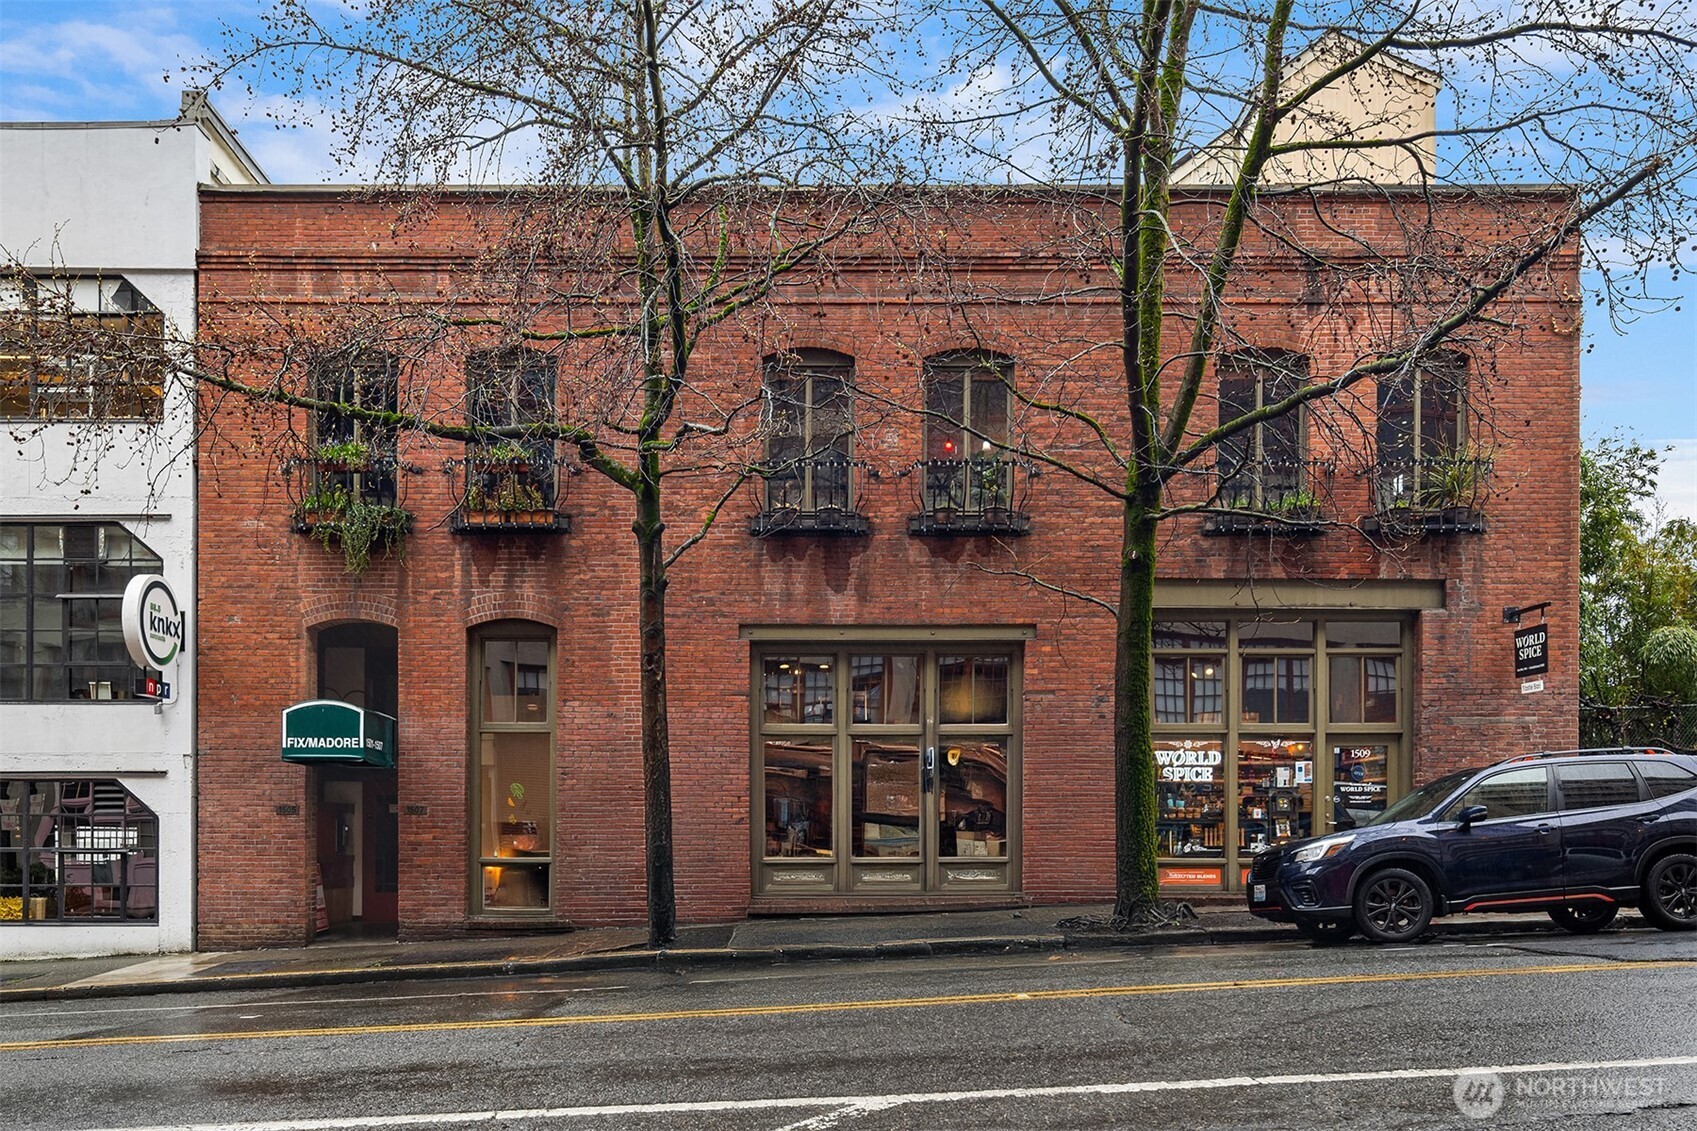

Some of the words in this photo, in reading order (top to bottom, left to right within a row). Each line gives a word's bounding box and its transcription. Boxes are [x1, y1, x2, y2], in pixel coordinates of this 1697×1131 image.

[150, 611, 180, 640] knkx
[1518, 645, 1542, 661] SPICE
[148, 682, 169, 696] npr
[287, 737, 359, 748] FIX/MADORE
[1351, 749, 1371, 758] 1509
[1162, 766, 1213, 782] SPICE
